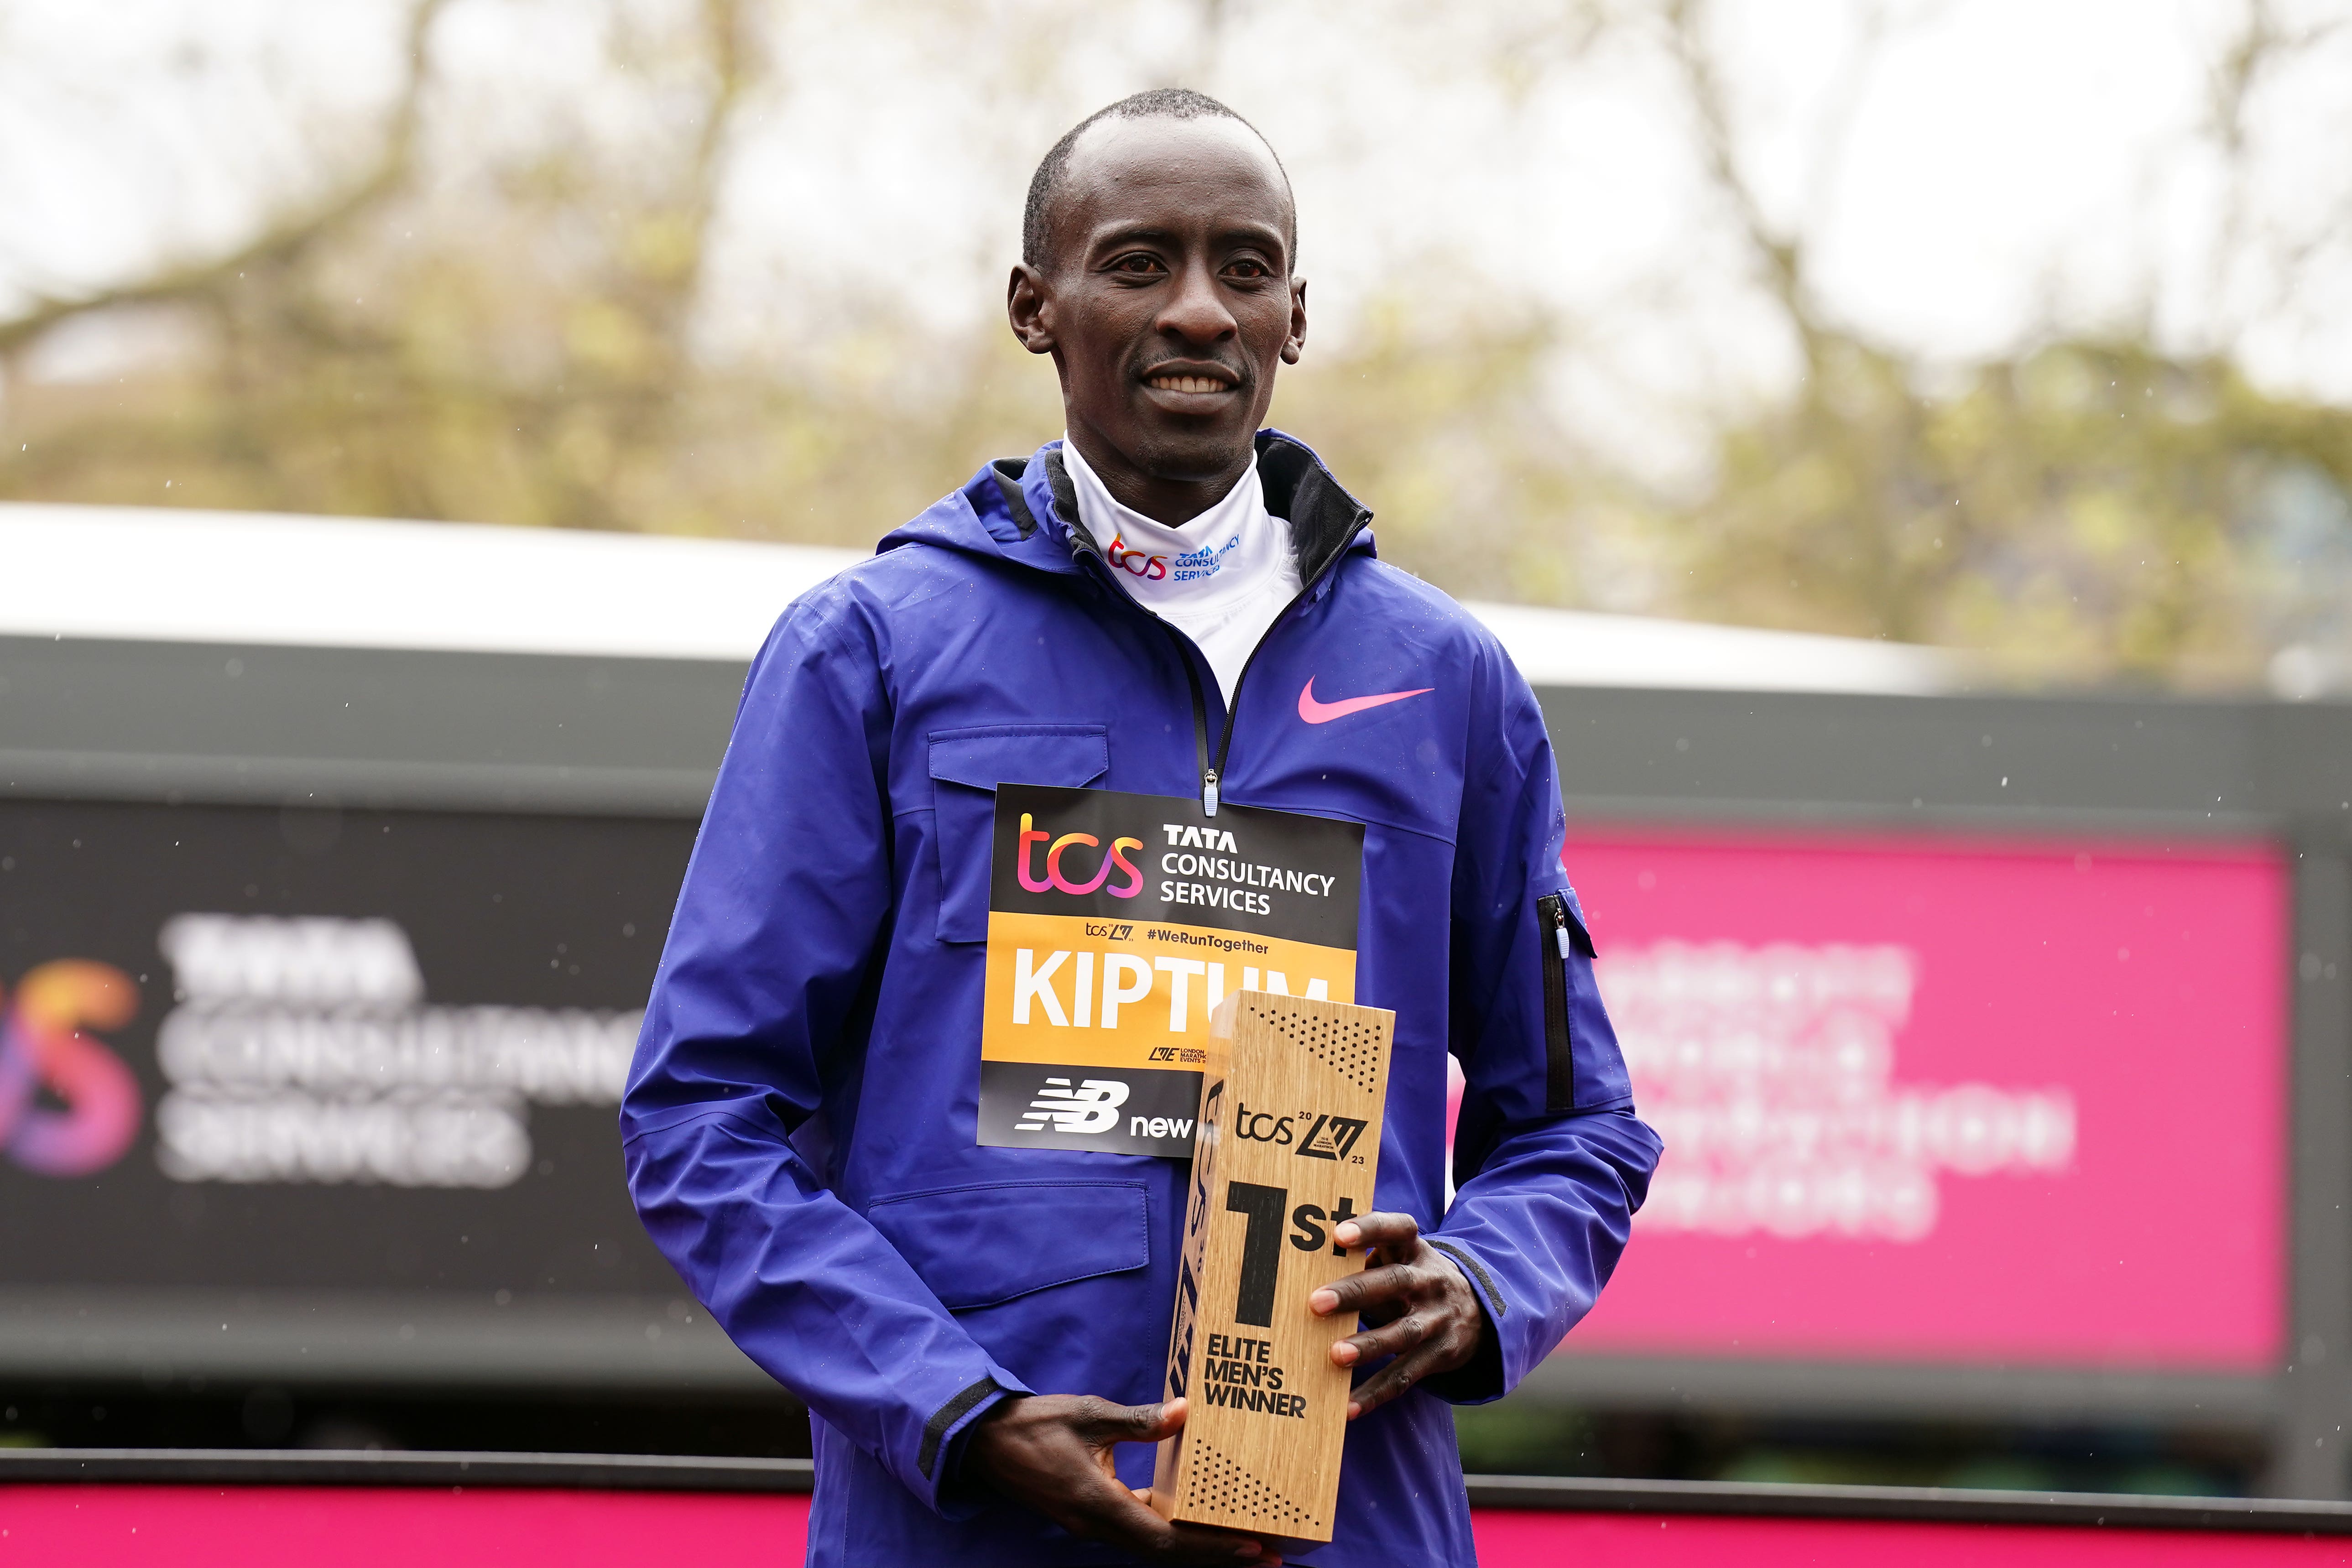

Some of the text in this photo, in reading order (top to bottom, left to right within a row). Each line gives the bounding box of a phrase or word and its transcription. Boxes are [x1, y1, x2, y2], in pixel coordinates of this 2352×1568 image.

[1108, 533, 1168, 580] tcs
[1175, 534, 1239, 567] CONSULTANCY
[1179, 545, 1213, 558] TATA
[1174, 565, 1220, 581] SERVICES
[1163, 824, 1237, 854] TATA
[1018, 813, 1143, 898] tcs
[1161, 854, 1335, 897] CONSULTANCY
[1160, 881, 1271, 915] SERVICES
[1086, 922, 1107, 937] tcs
[1147, 929, 1268, 954] #WeRunTogether
[1130, 1116, 1194, 1138] new
[1236, 1103, 1294, 1145] tcs
[1299, 1111, 1312, 1120] 20
[1352, 1156, 1364, 1164] 23
[1207, 1334, 1271, 1363] ELITE
[1205, 1358, 1283, 1390] MEN'S
[1205, 1383, 1306, 1419] WINNER
